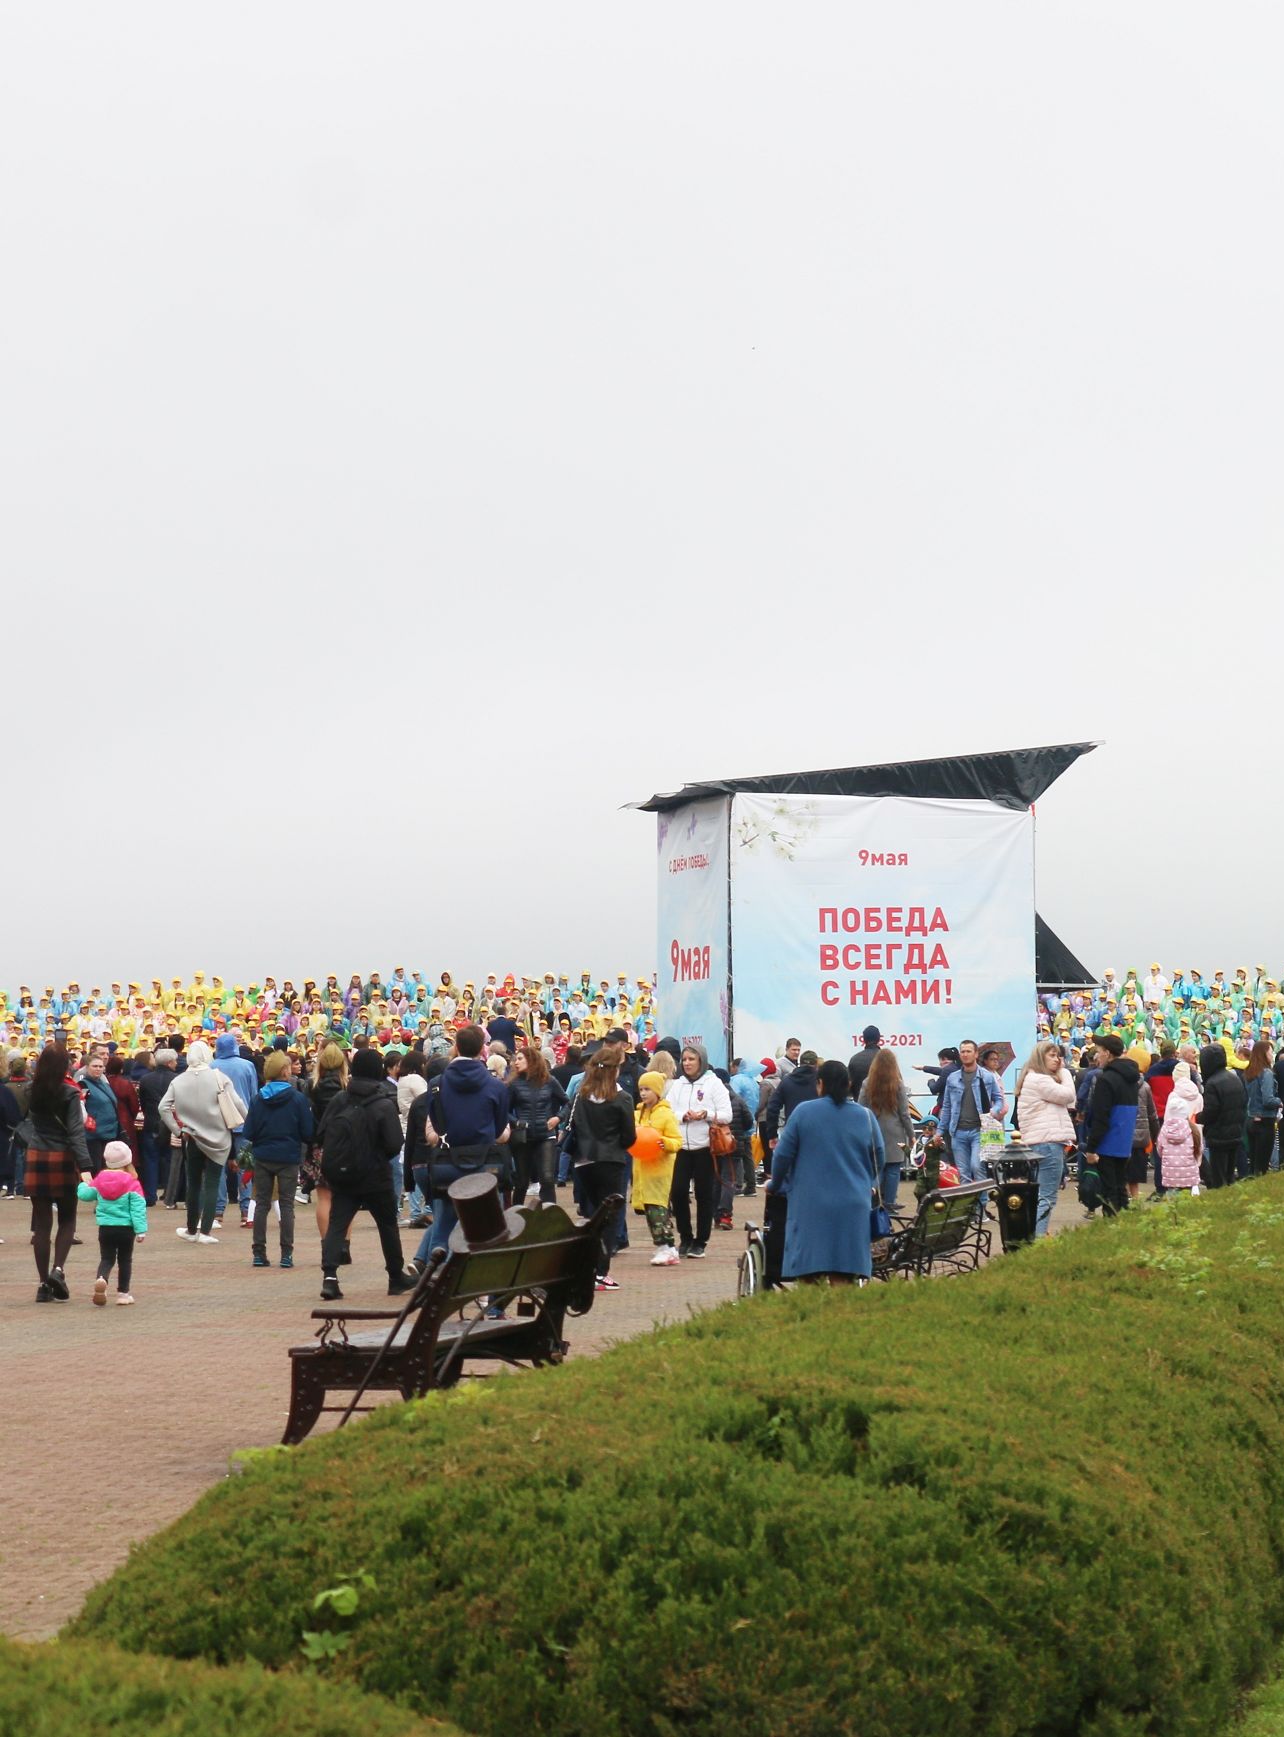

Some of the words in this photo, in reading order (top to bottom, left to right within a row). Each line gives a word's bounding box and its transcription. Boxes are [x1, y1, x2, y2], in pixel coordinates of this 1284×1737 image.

[858, 849, 910, 866] 9мая
[819, 906, 950, 937] ПОБЕДА
[671, 939, 711, 982] 9мая
[819, 942, 950, 975] ВСЕГДА
[820, 980, 840, 1007] С
[849, 979, 953, 1006] НАМИ!
[852, 1034, 923, 1047] 195-2021
